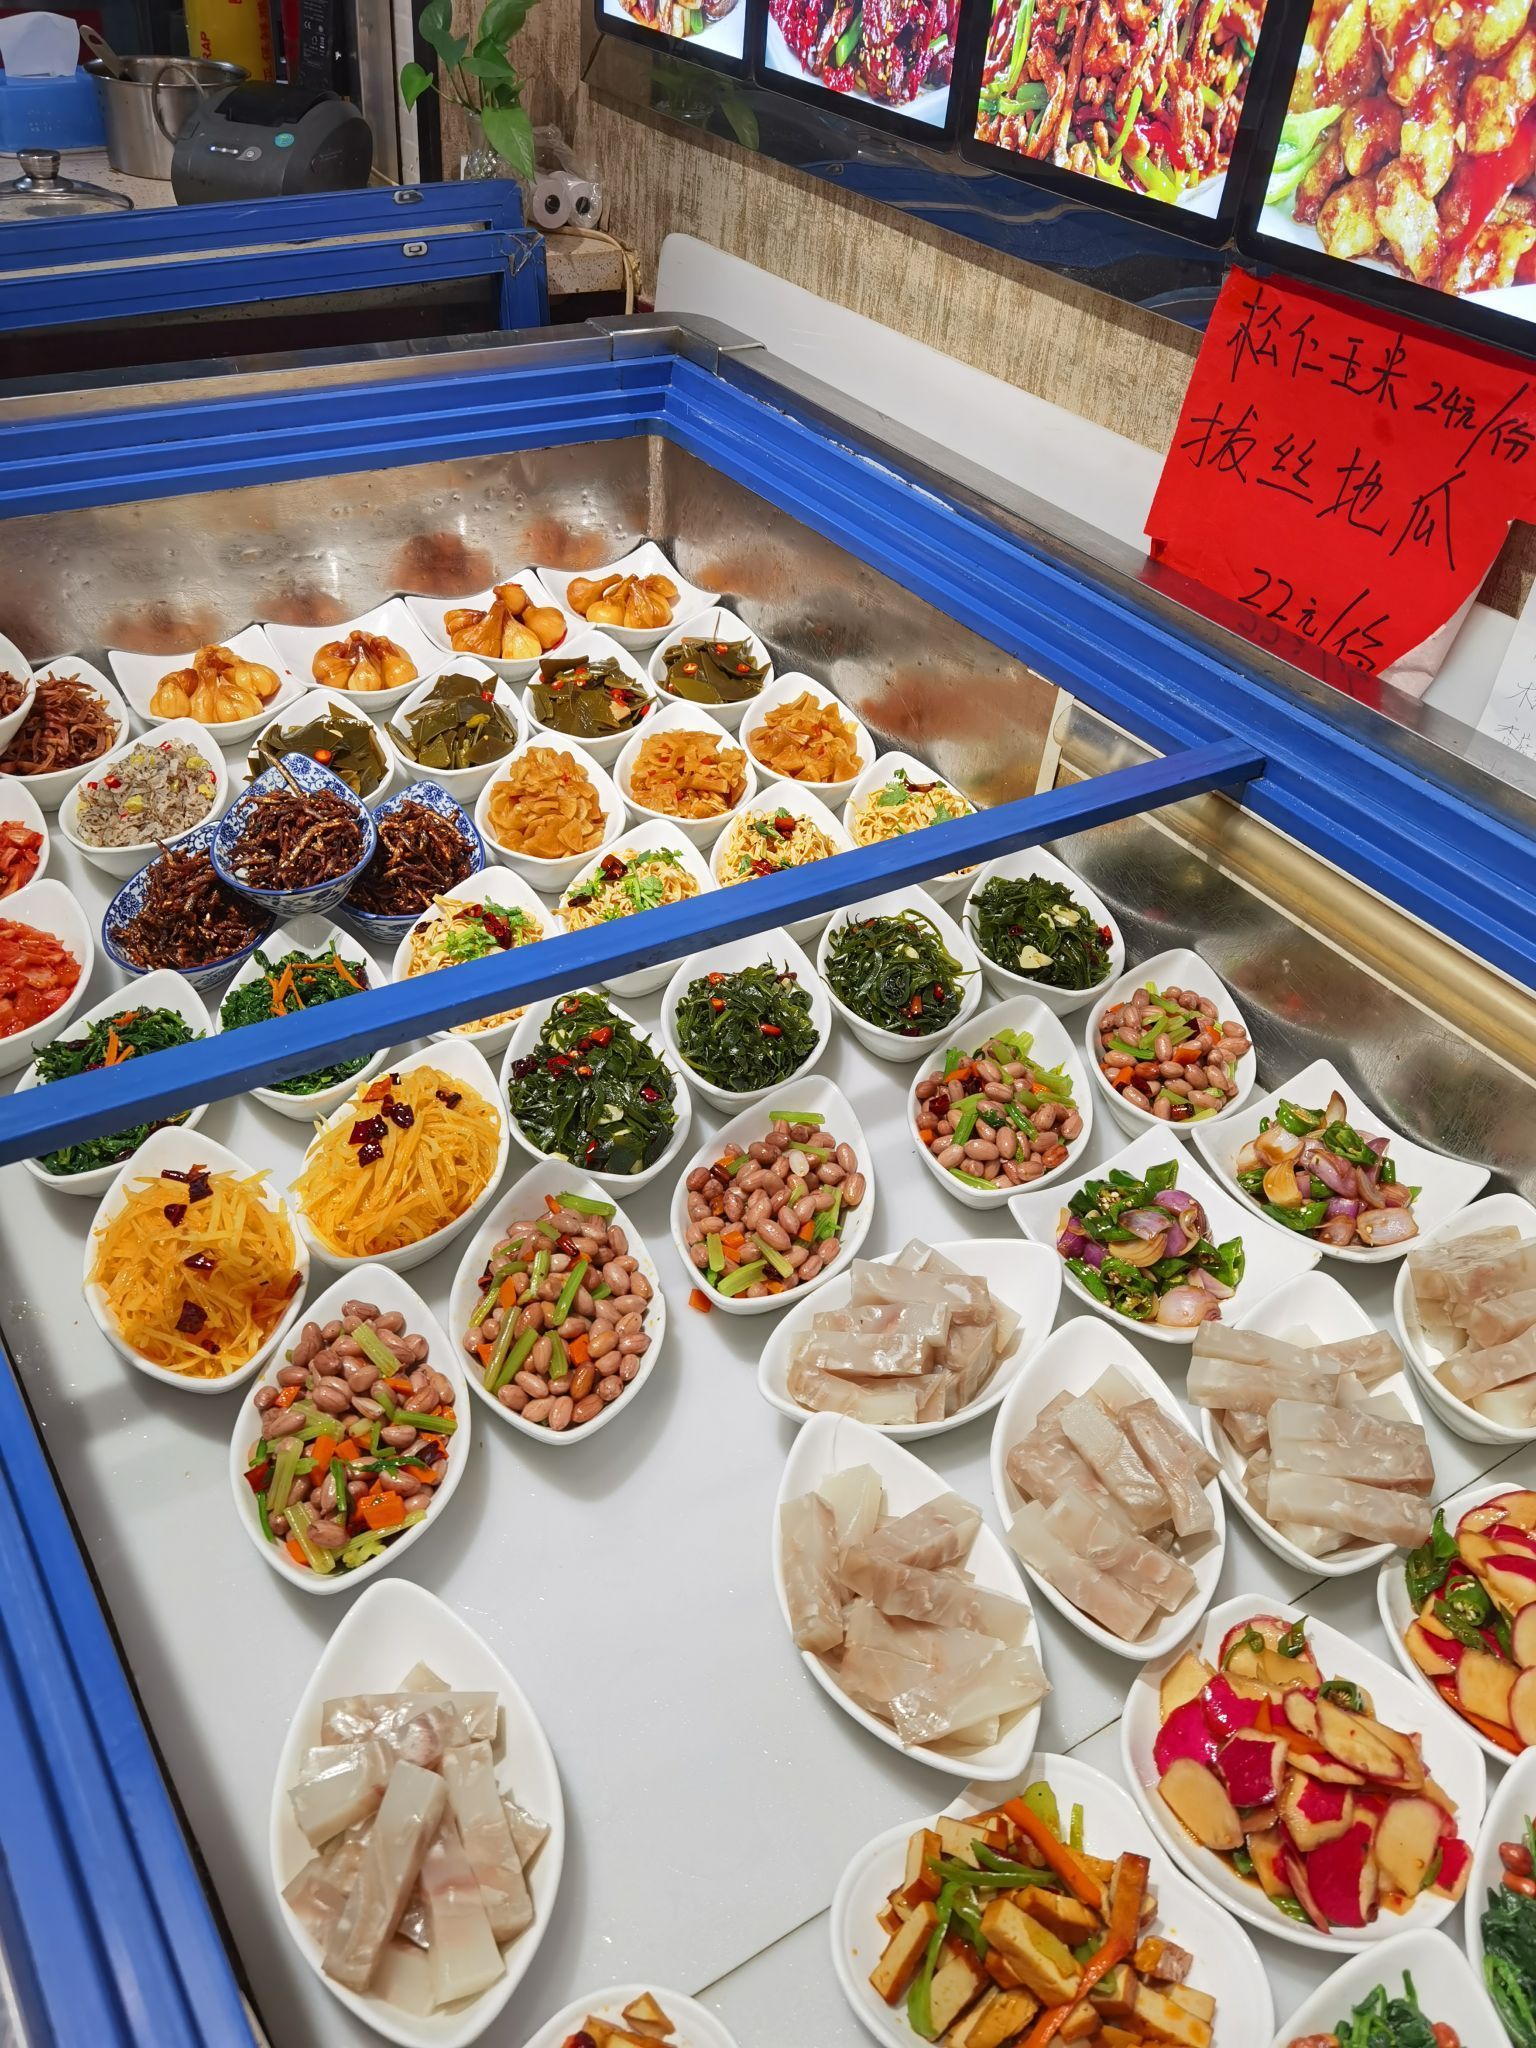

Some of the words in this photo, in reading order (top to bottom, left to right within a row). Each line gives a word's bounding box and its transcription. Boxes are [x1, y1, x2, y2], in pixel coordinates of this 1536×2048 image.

[1226, 287, 1408, 410] 松仁玉米
[1180, 402, 1466, 571] 拔丝地瓜
